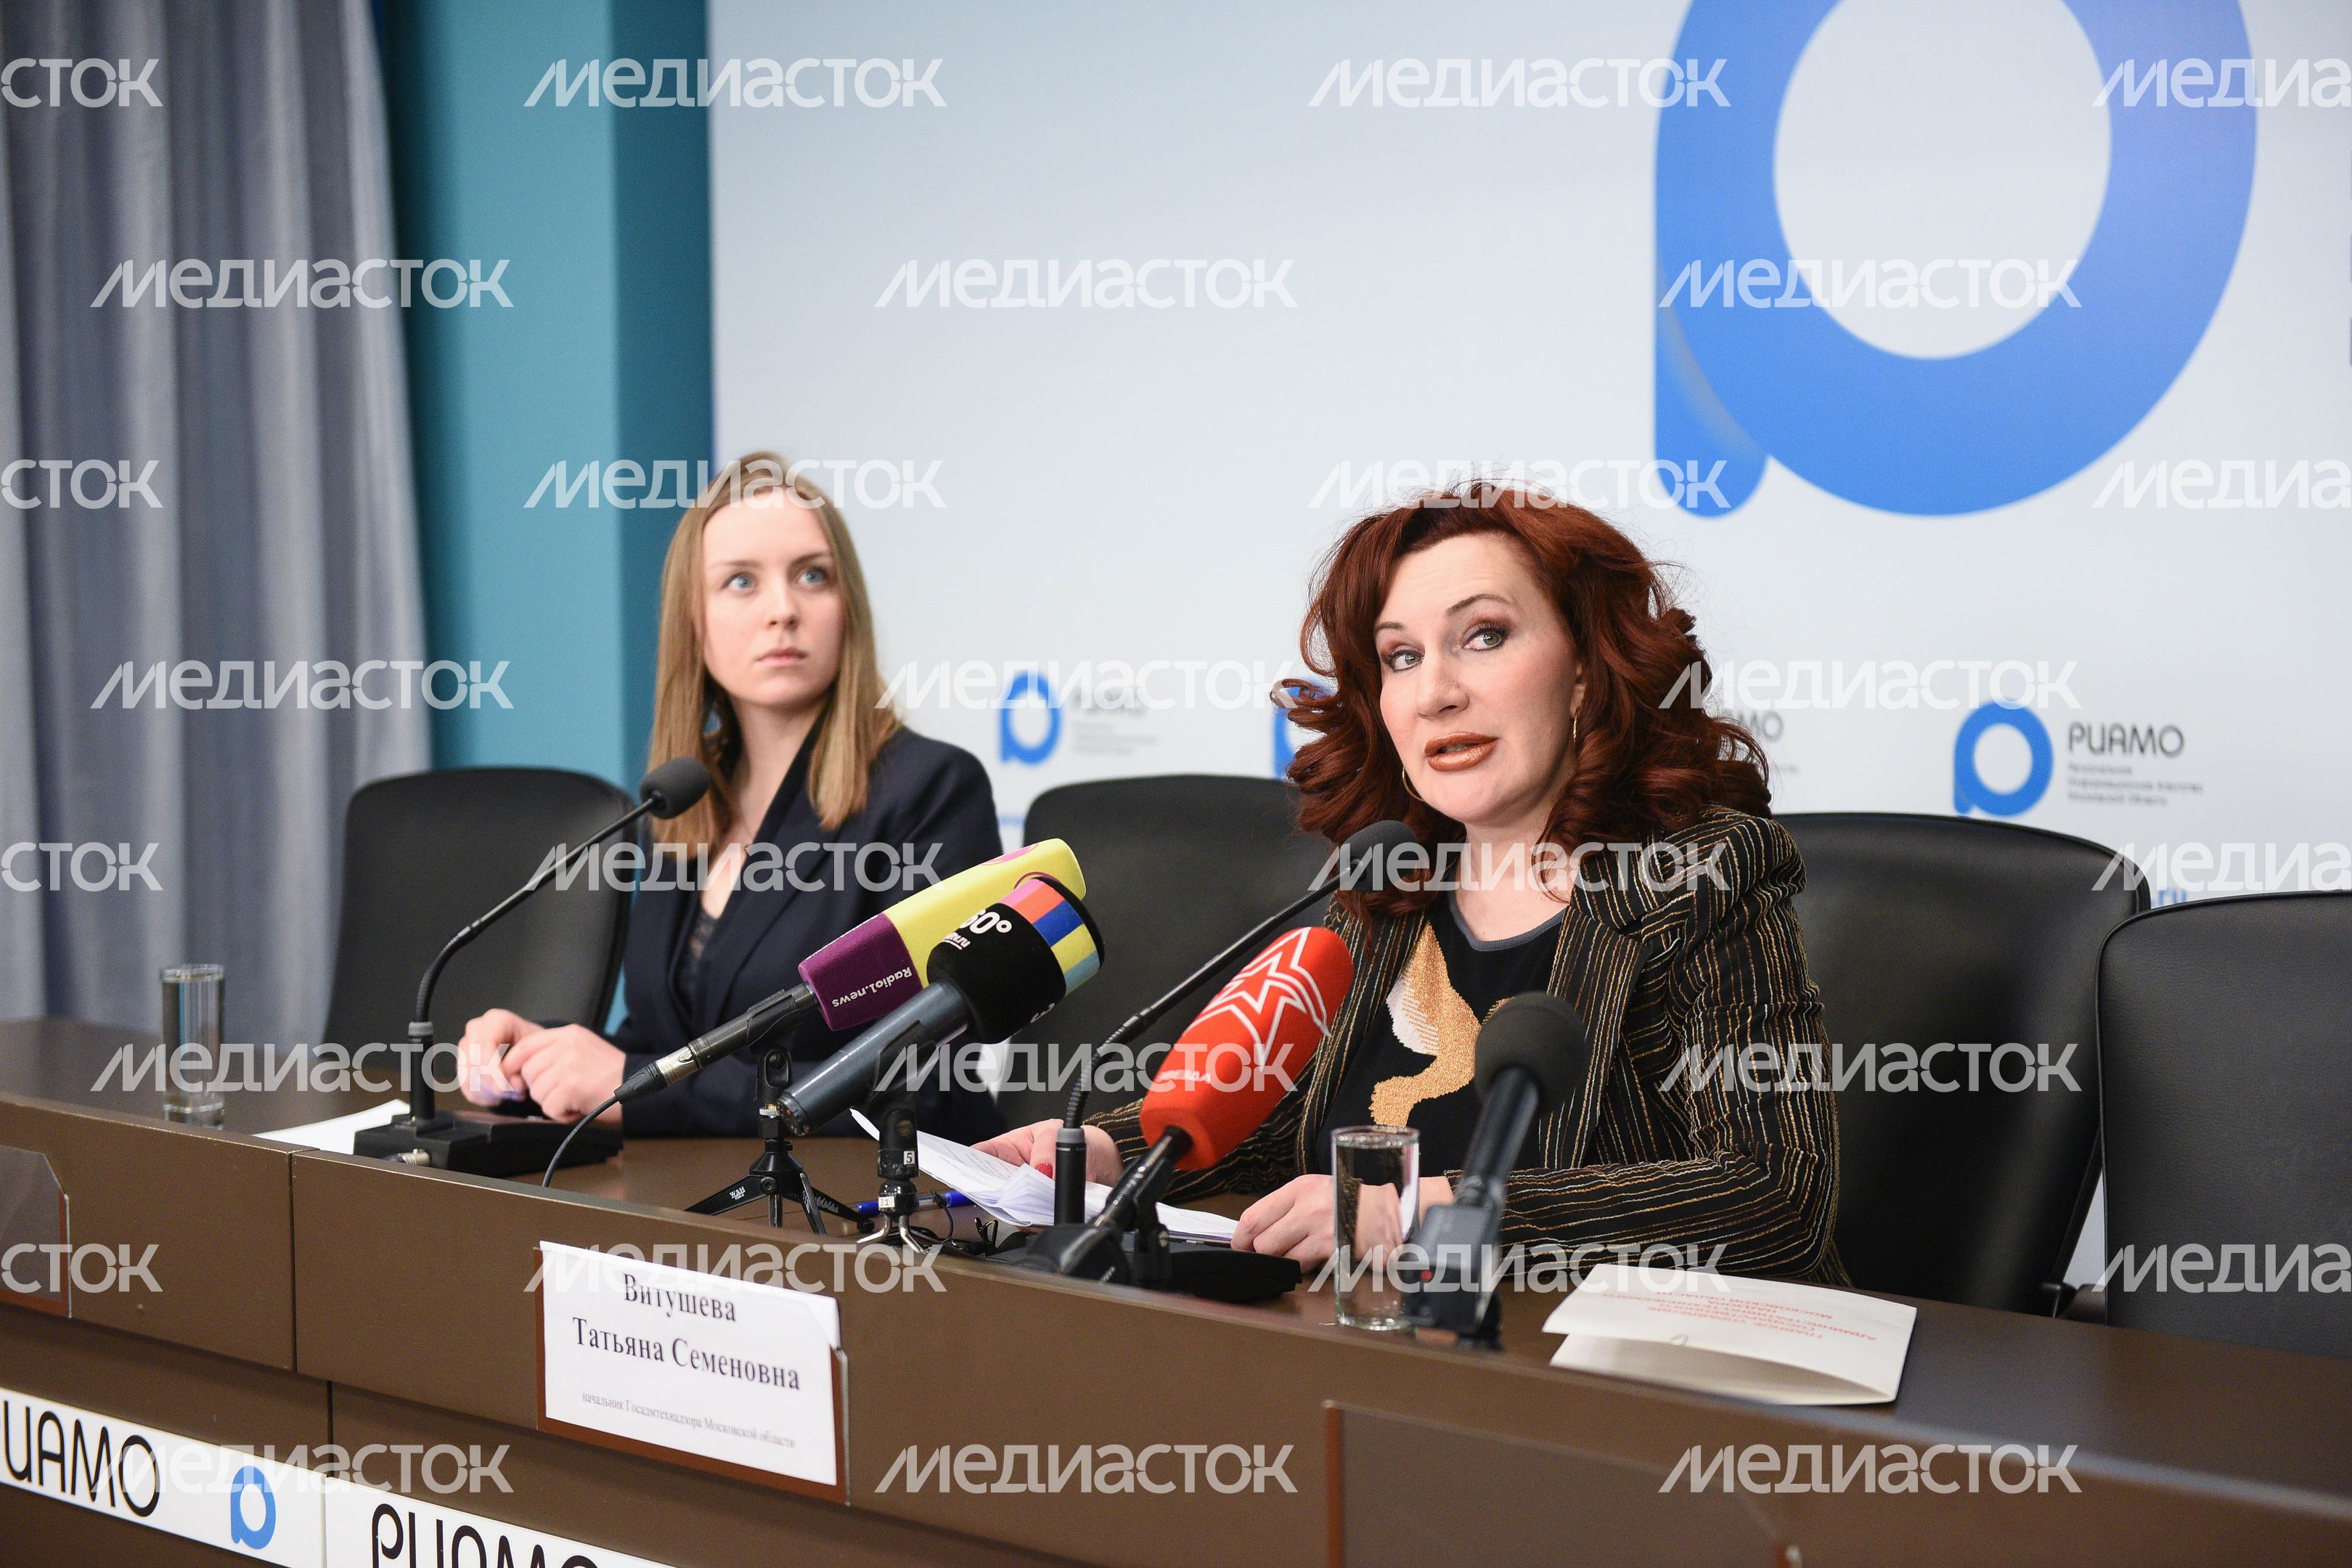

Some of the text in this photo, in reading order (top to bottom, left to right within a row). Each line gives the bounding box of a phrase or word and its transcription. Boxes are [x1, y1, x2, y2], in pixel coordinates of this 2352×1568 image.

[832, 967, 912, 1007] Radio1.news
[907, 1153, 912, 1163] 5
[624, 1273, 736, 1322] Витушева
[573, 1317, 800, 1390] Татьяна Семеновна
[582, 1393, 624, 1410] начальник
[0, 1399, 160, 1517] ИАМО
